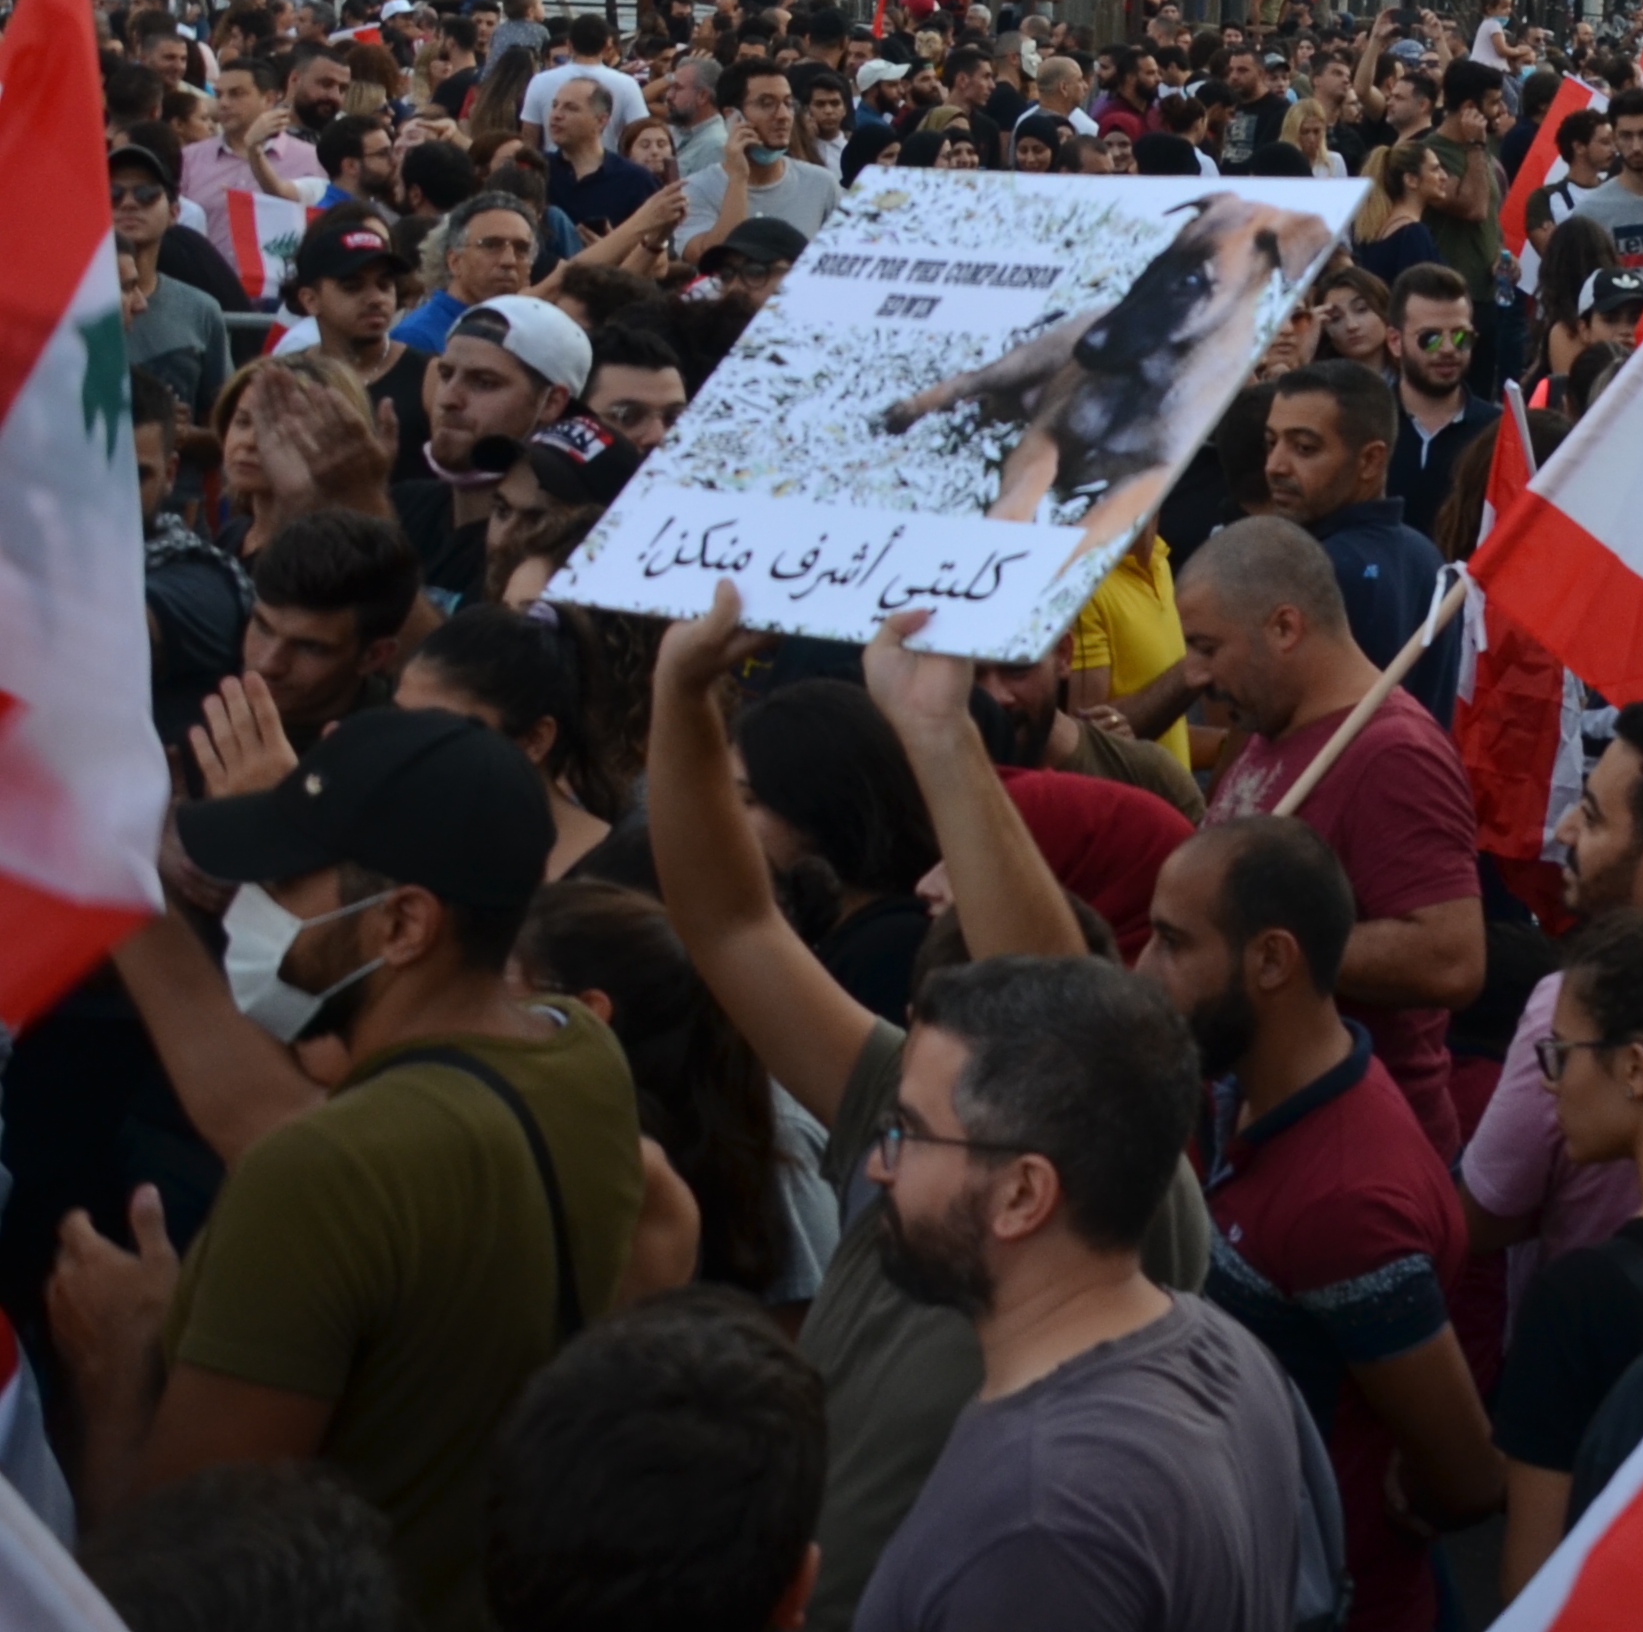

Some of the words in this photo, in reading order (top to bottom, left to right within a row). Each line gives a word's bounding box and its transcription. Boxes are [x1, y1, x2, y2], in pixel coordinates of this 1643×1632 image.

[810, 252, 872, 279] SORRY
[867, 256, 909, 282] FOR
[905, 259, 948, 284] THE
[943, 260, 1064, 290] COMPARISON
[876, 293, 942, 319] EDWIN
[769, 524, 906, 601] أشرف
